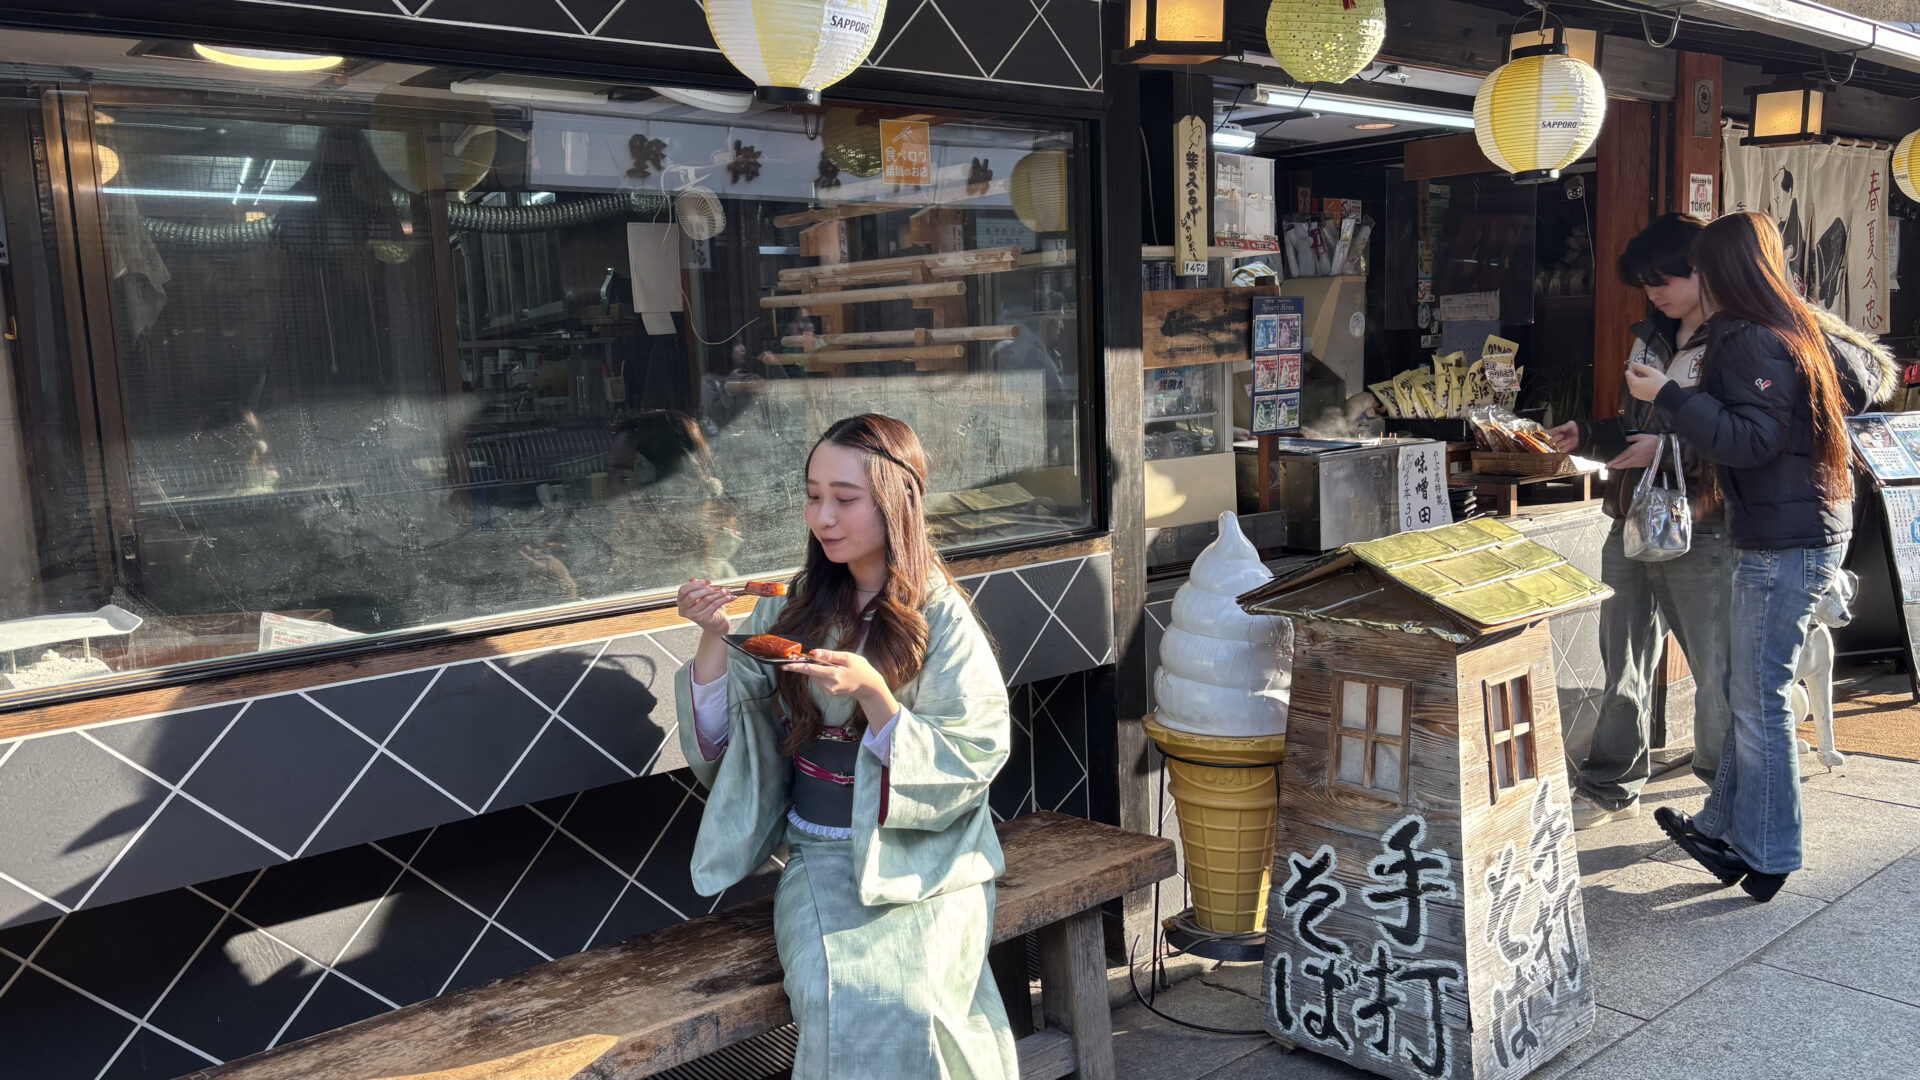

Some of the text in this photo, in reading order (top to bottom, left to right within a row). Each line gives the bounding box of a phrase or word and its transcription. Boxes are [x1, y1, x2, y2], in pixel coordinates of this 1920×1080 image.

[830, 15, 870, 35] SAPPORO
[885, 146, 928, 163] 食べログ
[886, 165, 929, 178] 話題のお店
[1691, 201, 1711, 213] TOKYO
[1861, 169, 1883, 329] 春夏冬忠
[1272, 846, 1360, 1054] そば
[1354, 815, 1463, 1079] 手打
[1485, 841, 1540, 1070] そば
[1529, 776, 1580, 1004] 手打
